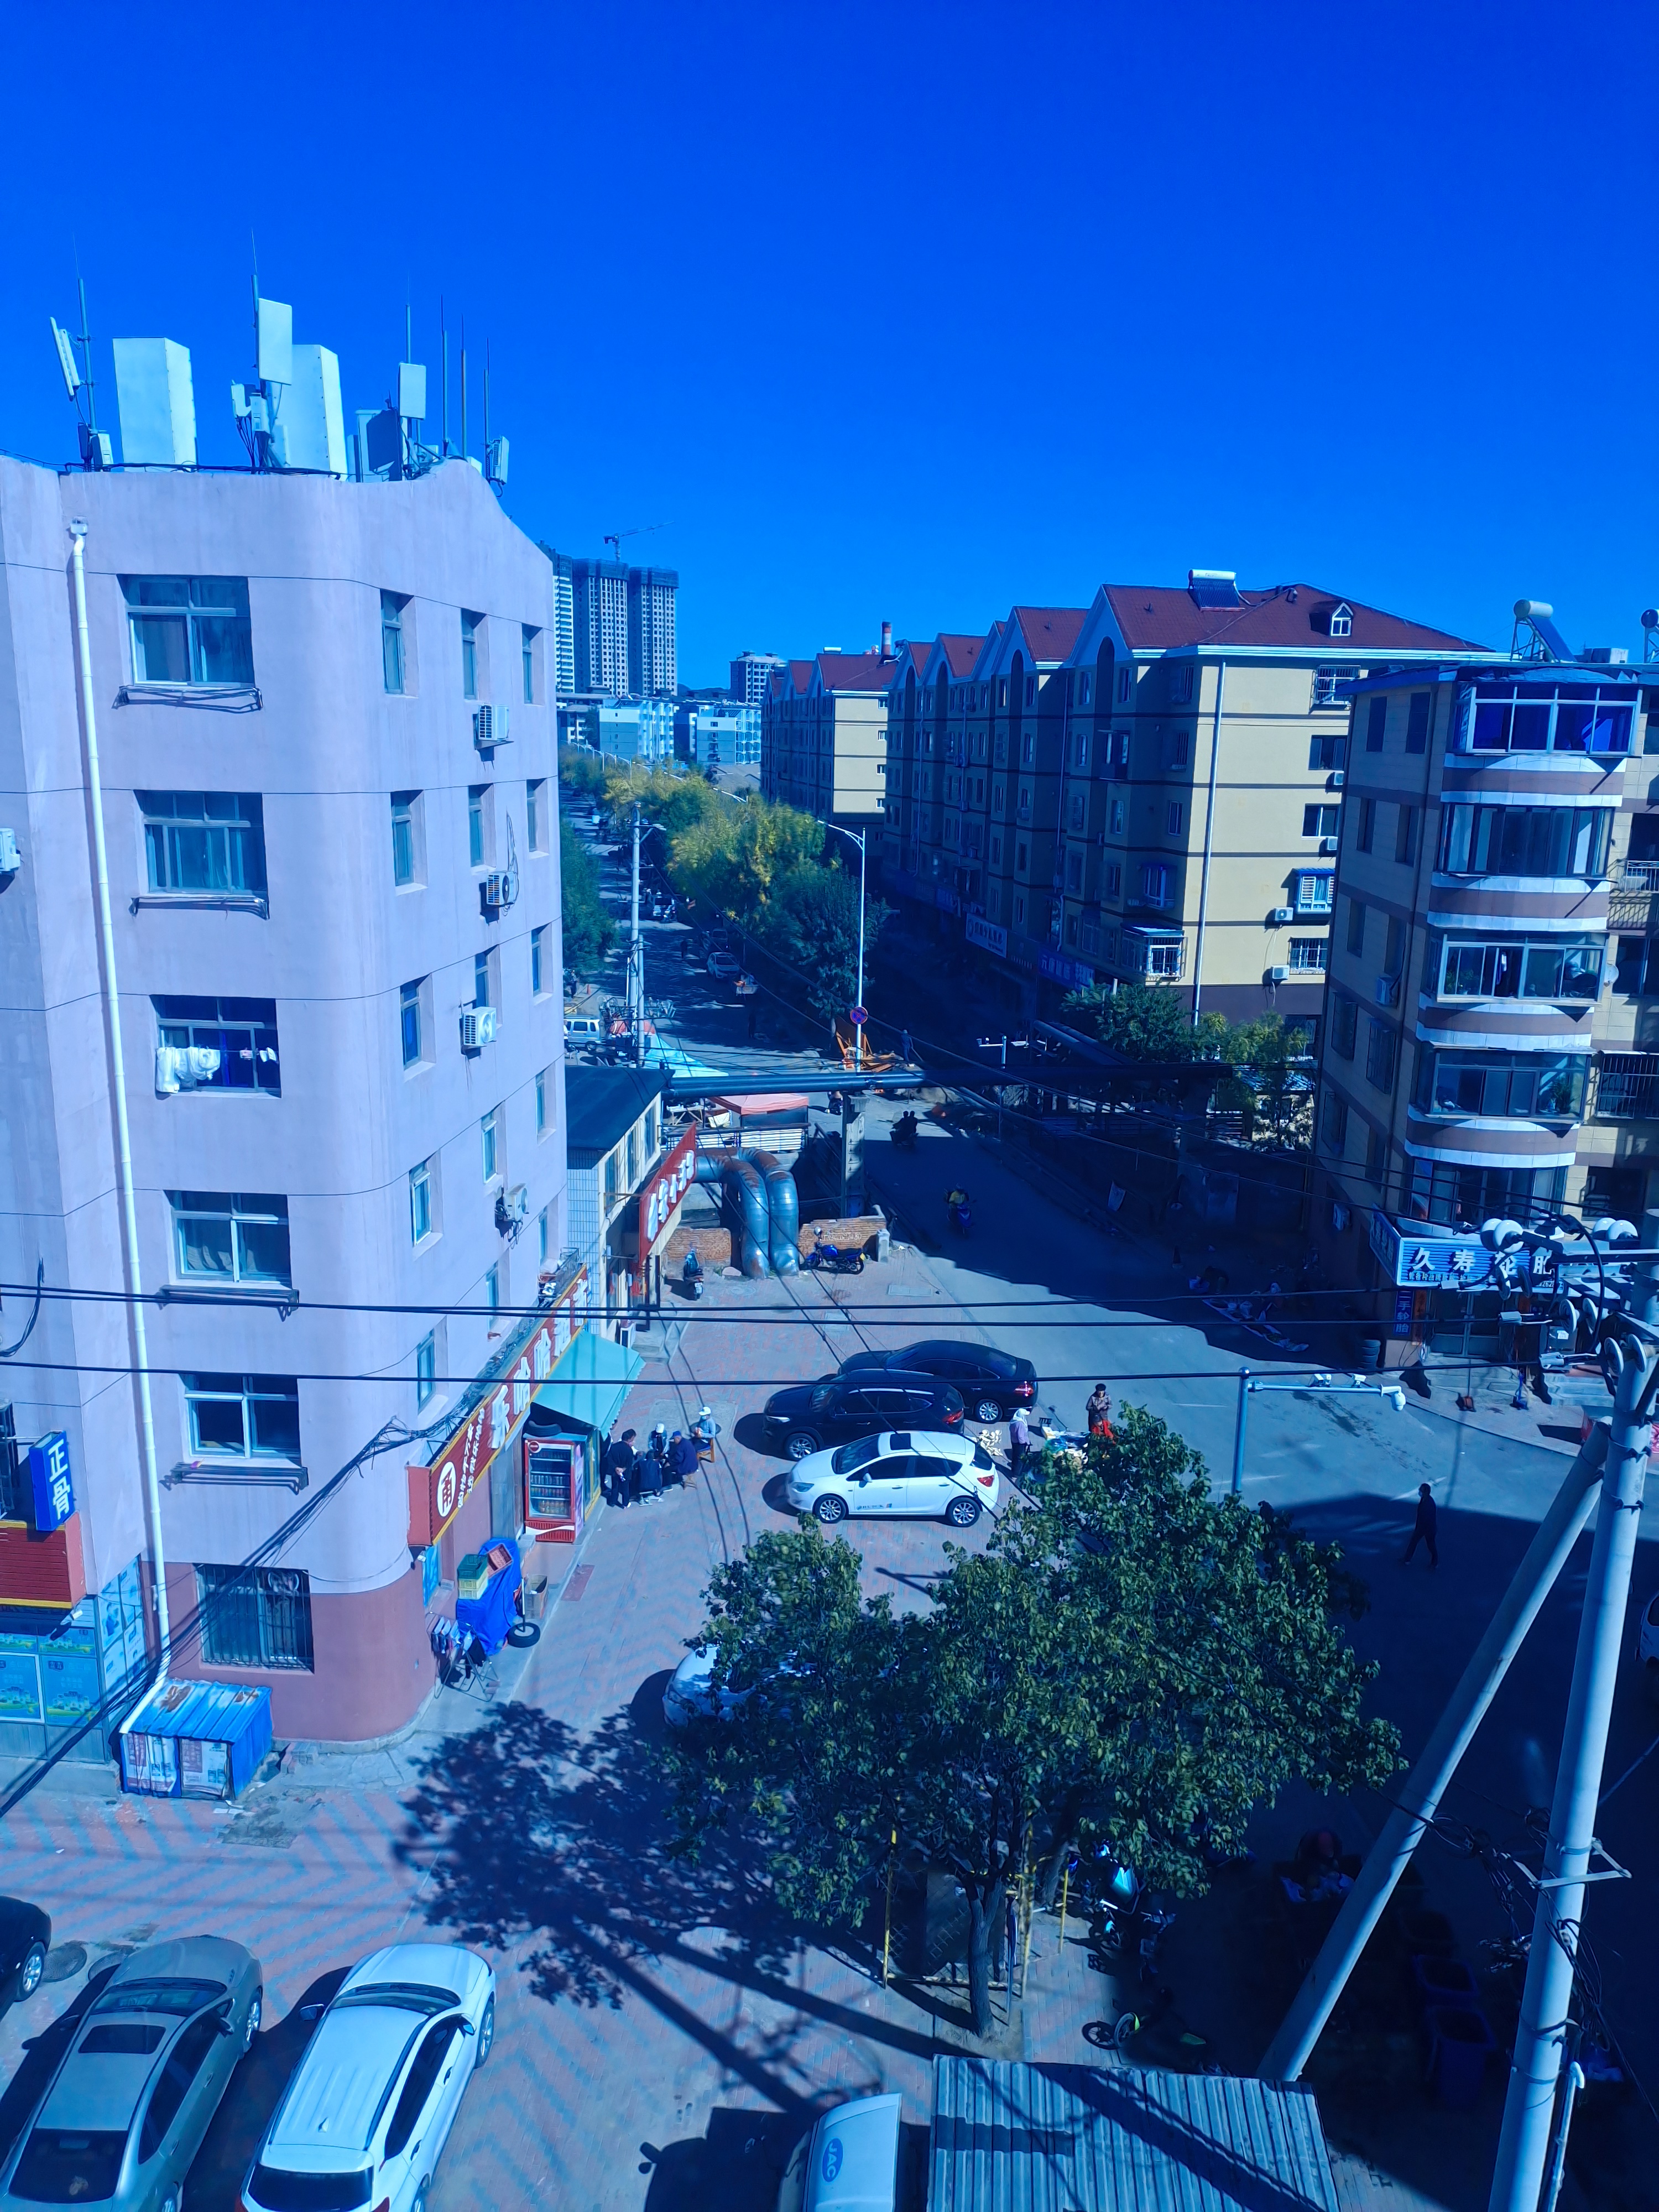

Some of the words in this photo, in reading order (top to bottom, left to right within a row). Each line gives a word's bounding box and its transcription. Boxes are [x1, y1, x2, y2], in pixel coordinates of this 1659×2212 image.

[1395, 1290, 1411, 1333] 二手轮胎
[48, 1438, 70, 1520] 正骨
[827, 2142, 837, 2178] JAC
